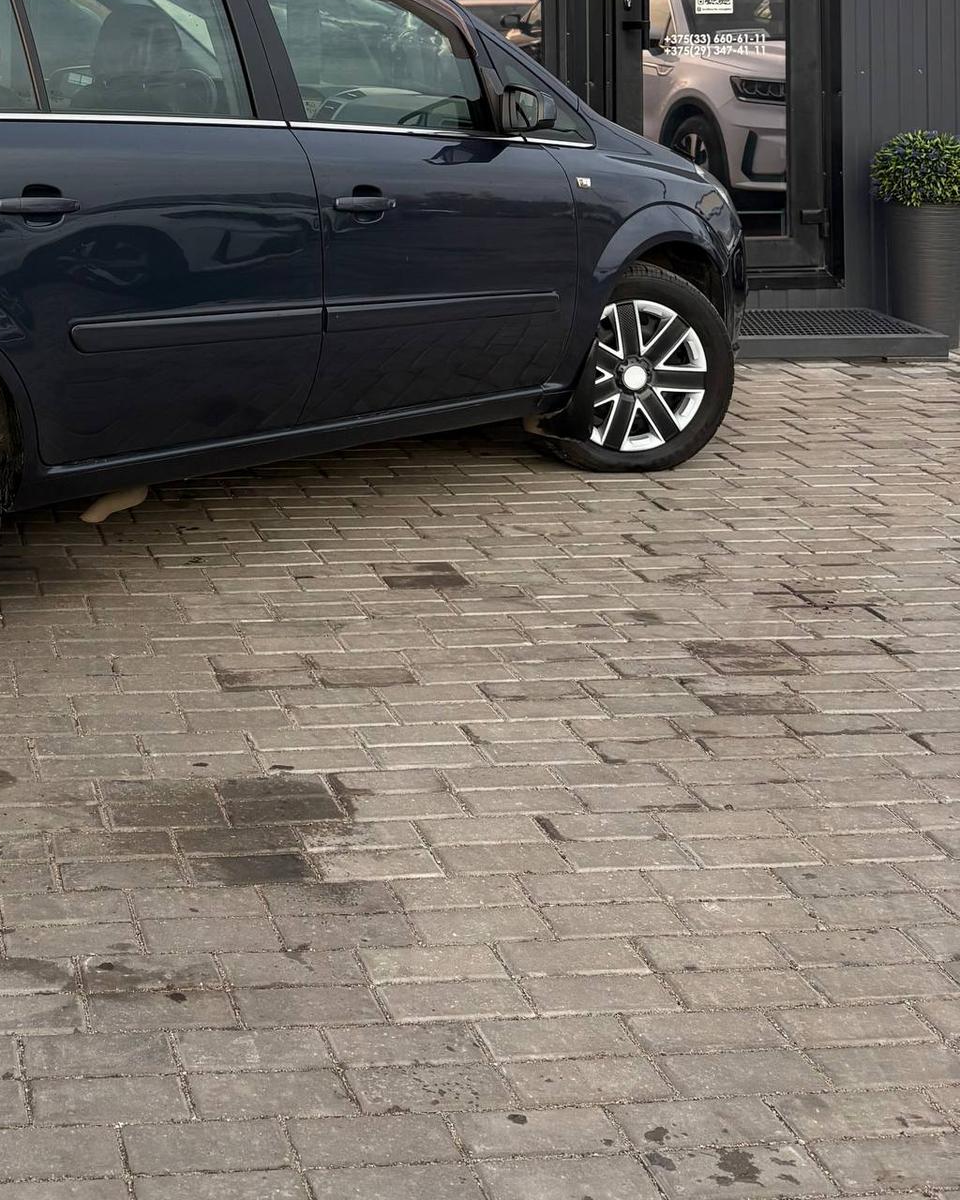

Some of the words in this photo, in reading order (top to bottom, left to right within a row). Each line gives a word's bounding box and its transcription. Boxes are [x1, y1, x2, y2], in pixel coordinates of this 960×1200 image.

[664, 33, 711, 45] +375(33)
[713, 33, 766, 44] 660-61-11
[664, 45, 711, 57] +375(29)
